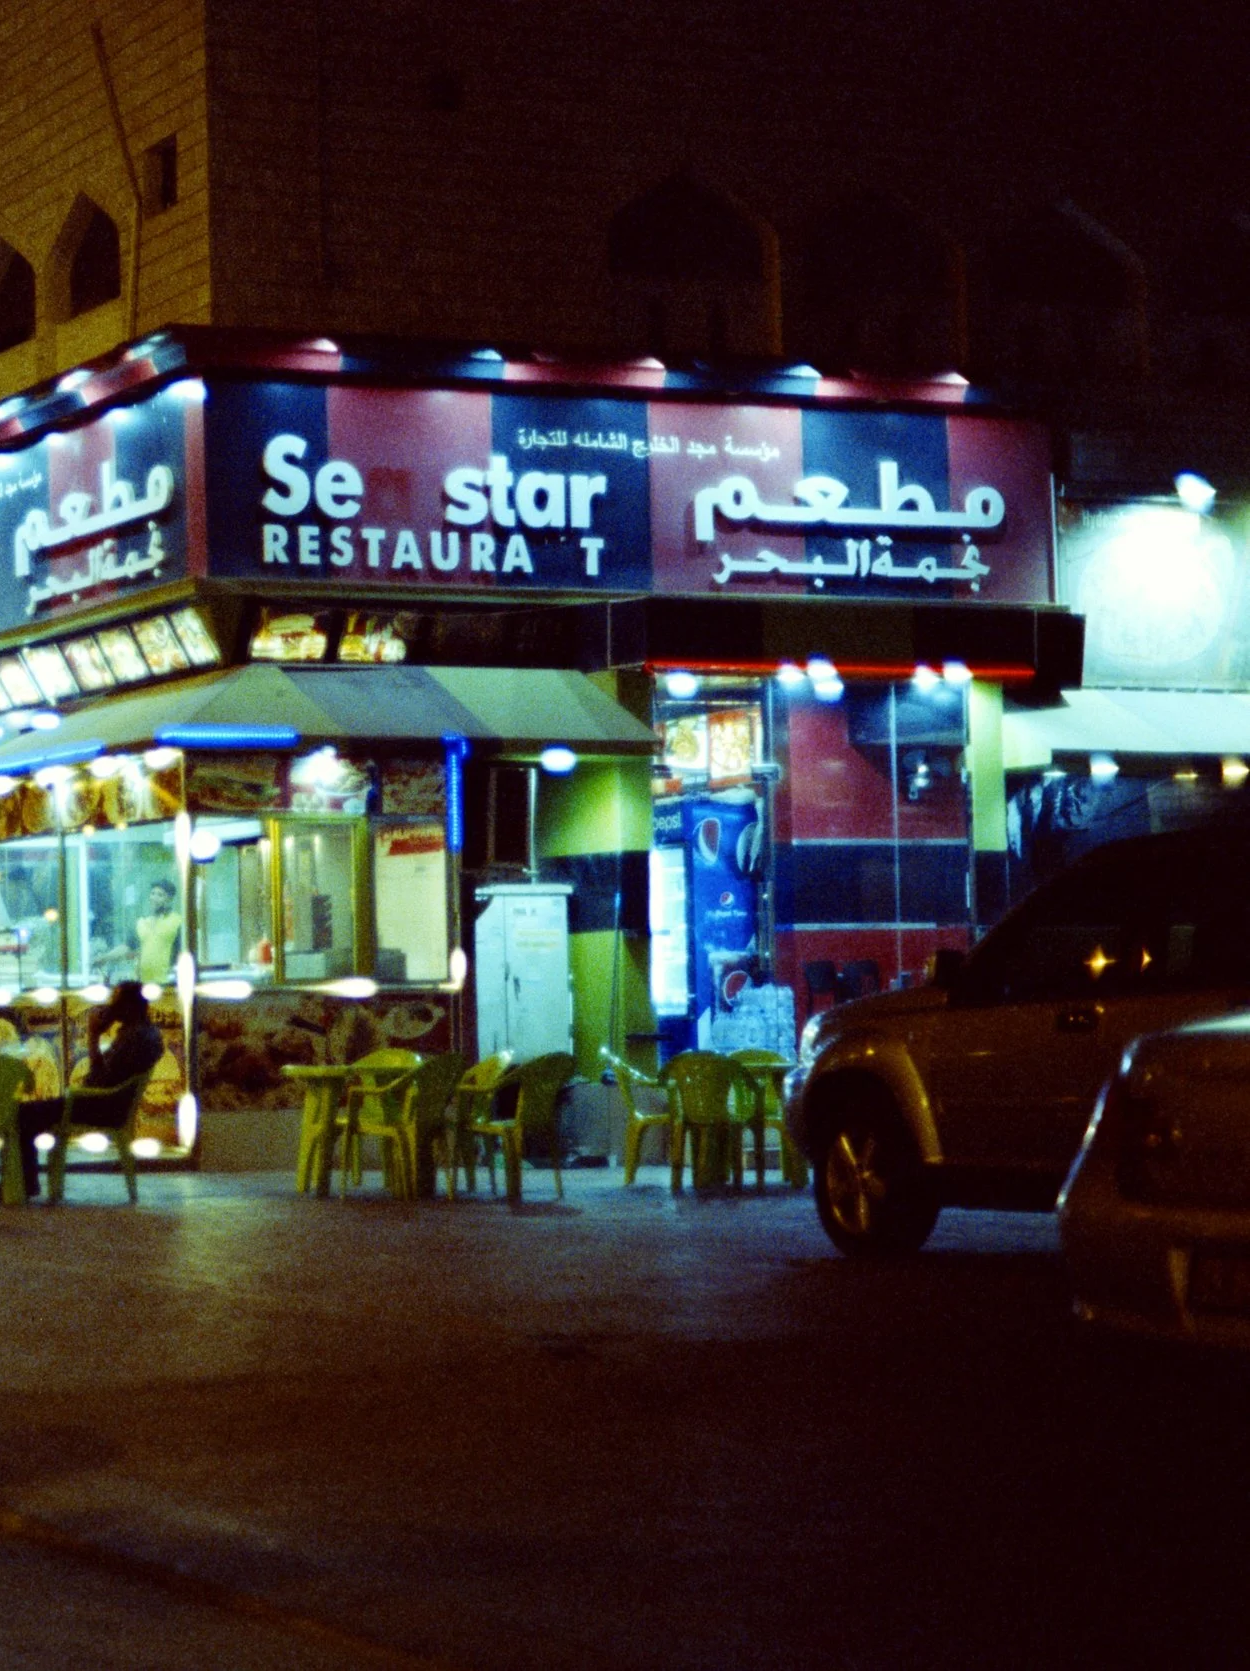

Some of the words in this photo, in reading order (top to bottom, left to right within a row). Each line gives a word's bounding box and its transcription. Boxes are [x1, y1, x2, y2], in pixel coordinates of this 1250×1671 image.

[15, 460, 174, 578] مطعم
[444, 454, 607, 529] star
[694, 460, 1005, 541] مطعم
